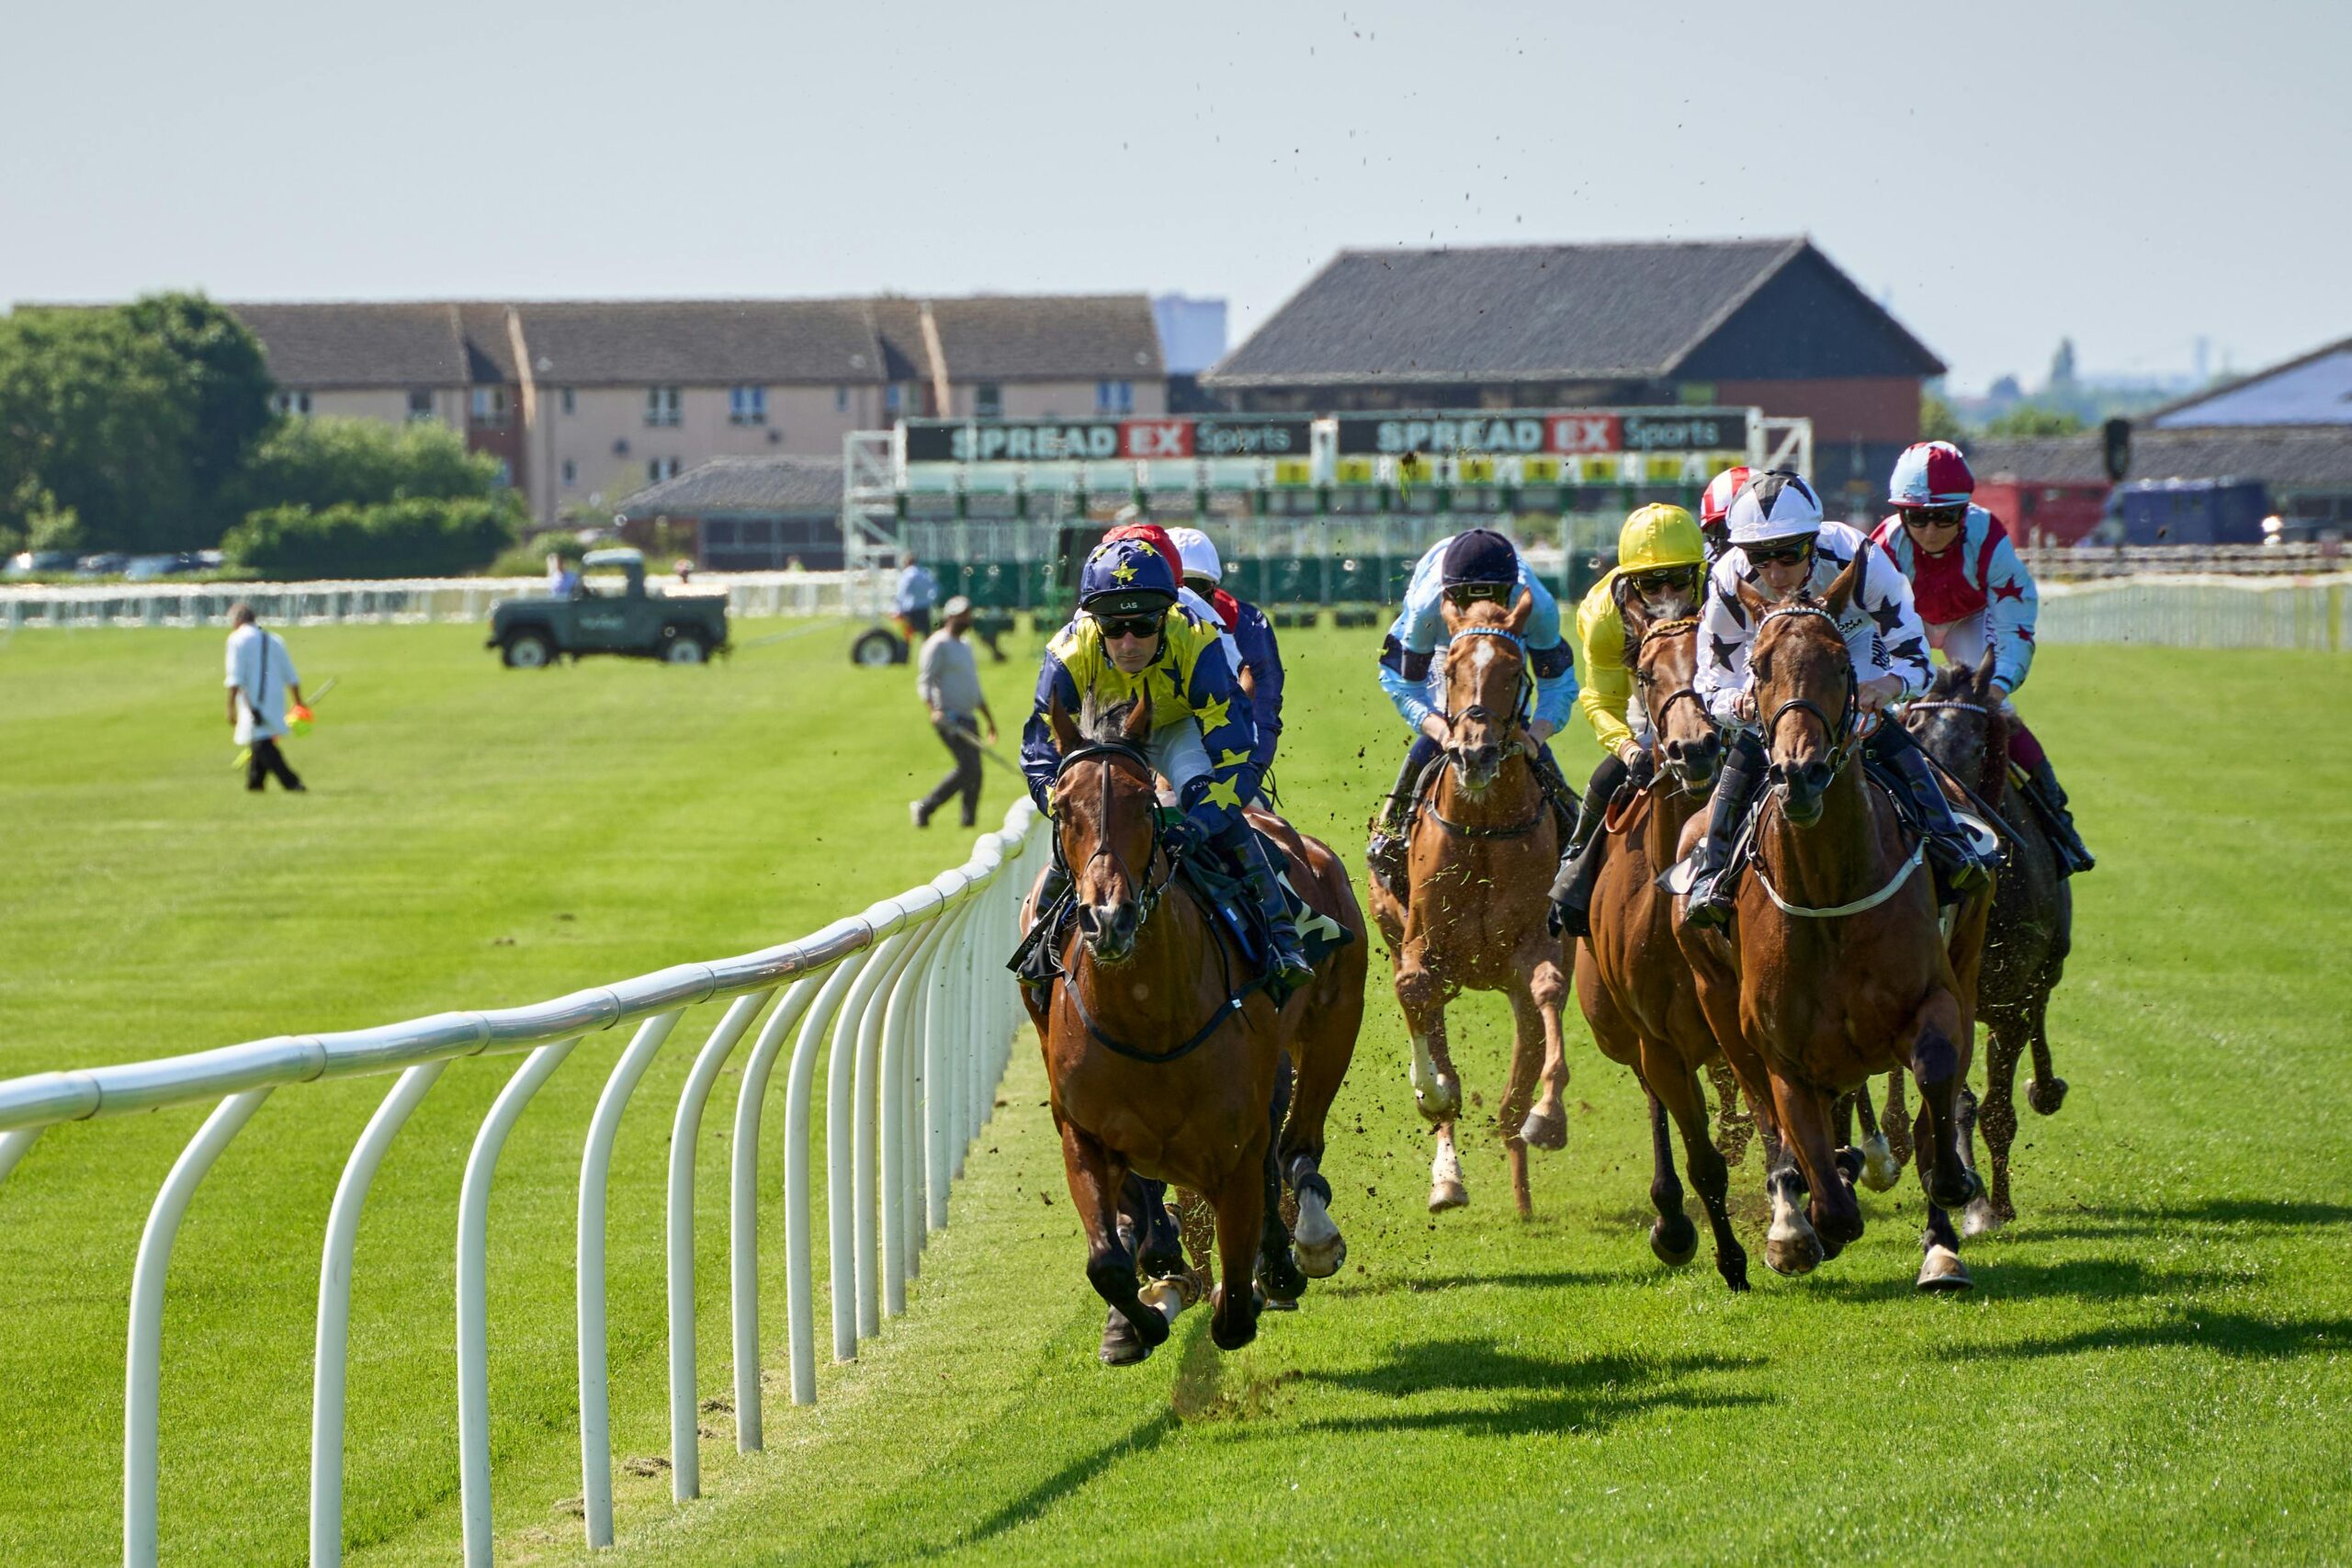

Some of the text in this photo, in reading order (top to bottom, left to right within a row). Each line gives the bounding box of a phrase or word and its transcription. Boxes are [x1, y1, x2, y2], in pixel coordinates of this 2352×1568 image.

[1195, 421, 1291, 454] Sports
[1624, 417, 1720, 452] Sports
[1120, 602, 1138, 610] LAS
